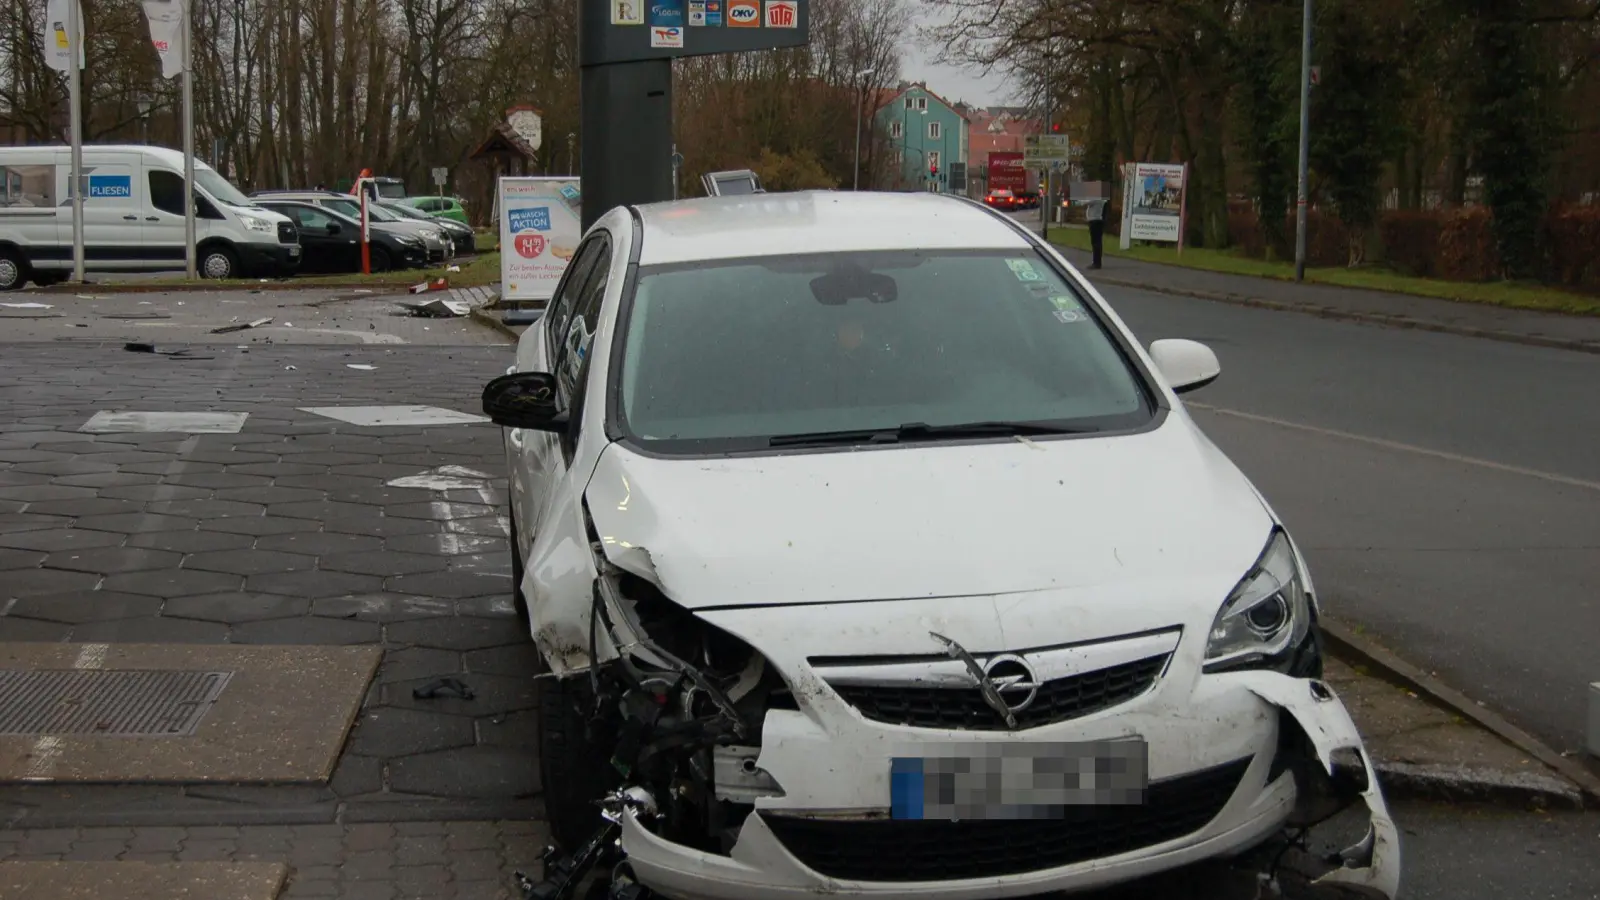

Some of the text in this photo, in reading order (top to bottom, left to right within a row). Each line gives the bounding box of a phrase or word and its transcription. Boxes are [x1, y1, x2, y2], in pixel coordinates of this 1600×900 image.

[732, 9, 755, 18] DKV
[769, 4, 795, 25] UTA
[91, 186, 129, 195] FLIESEN
[513, 218, 547, 229] AKTION
